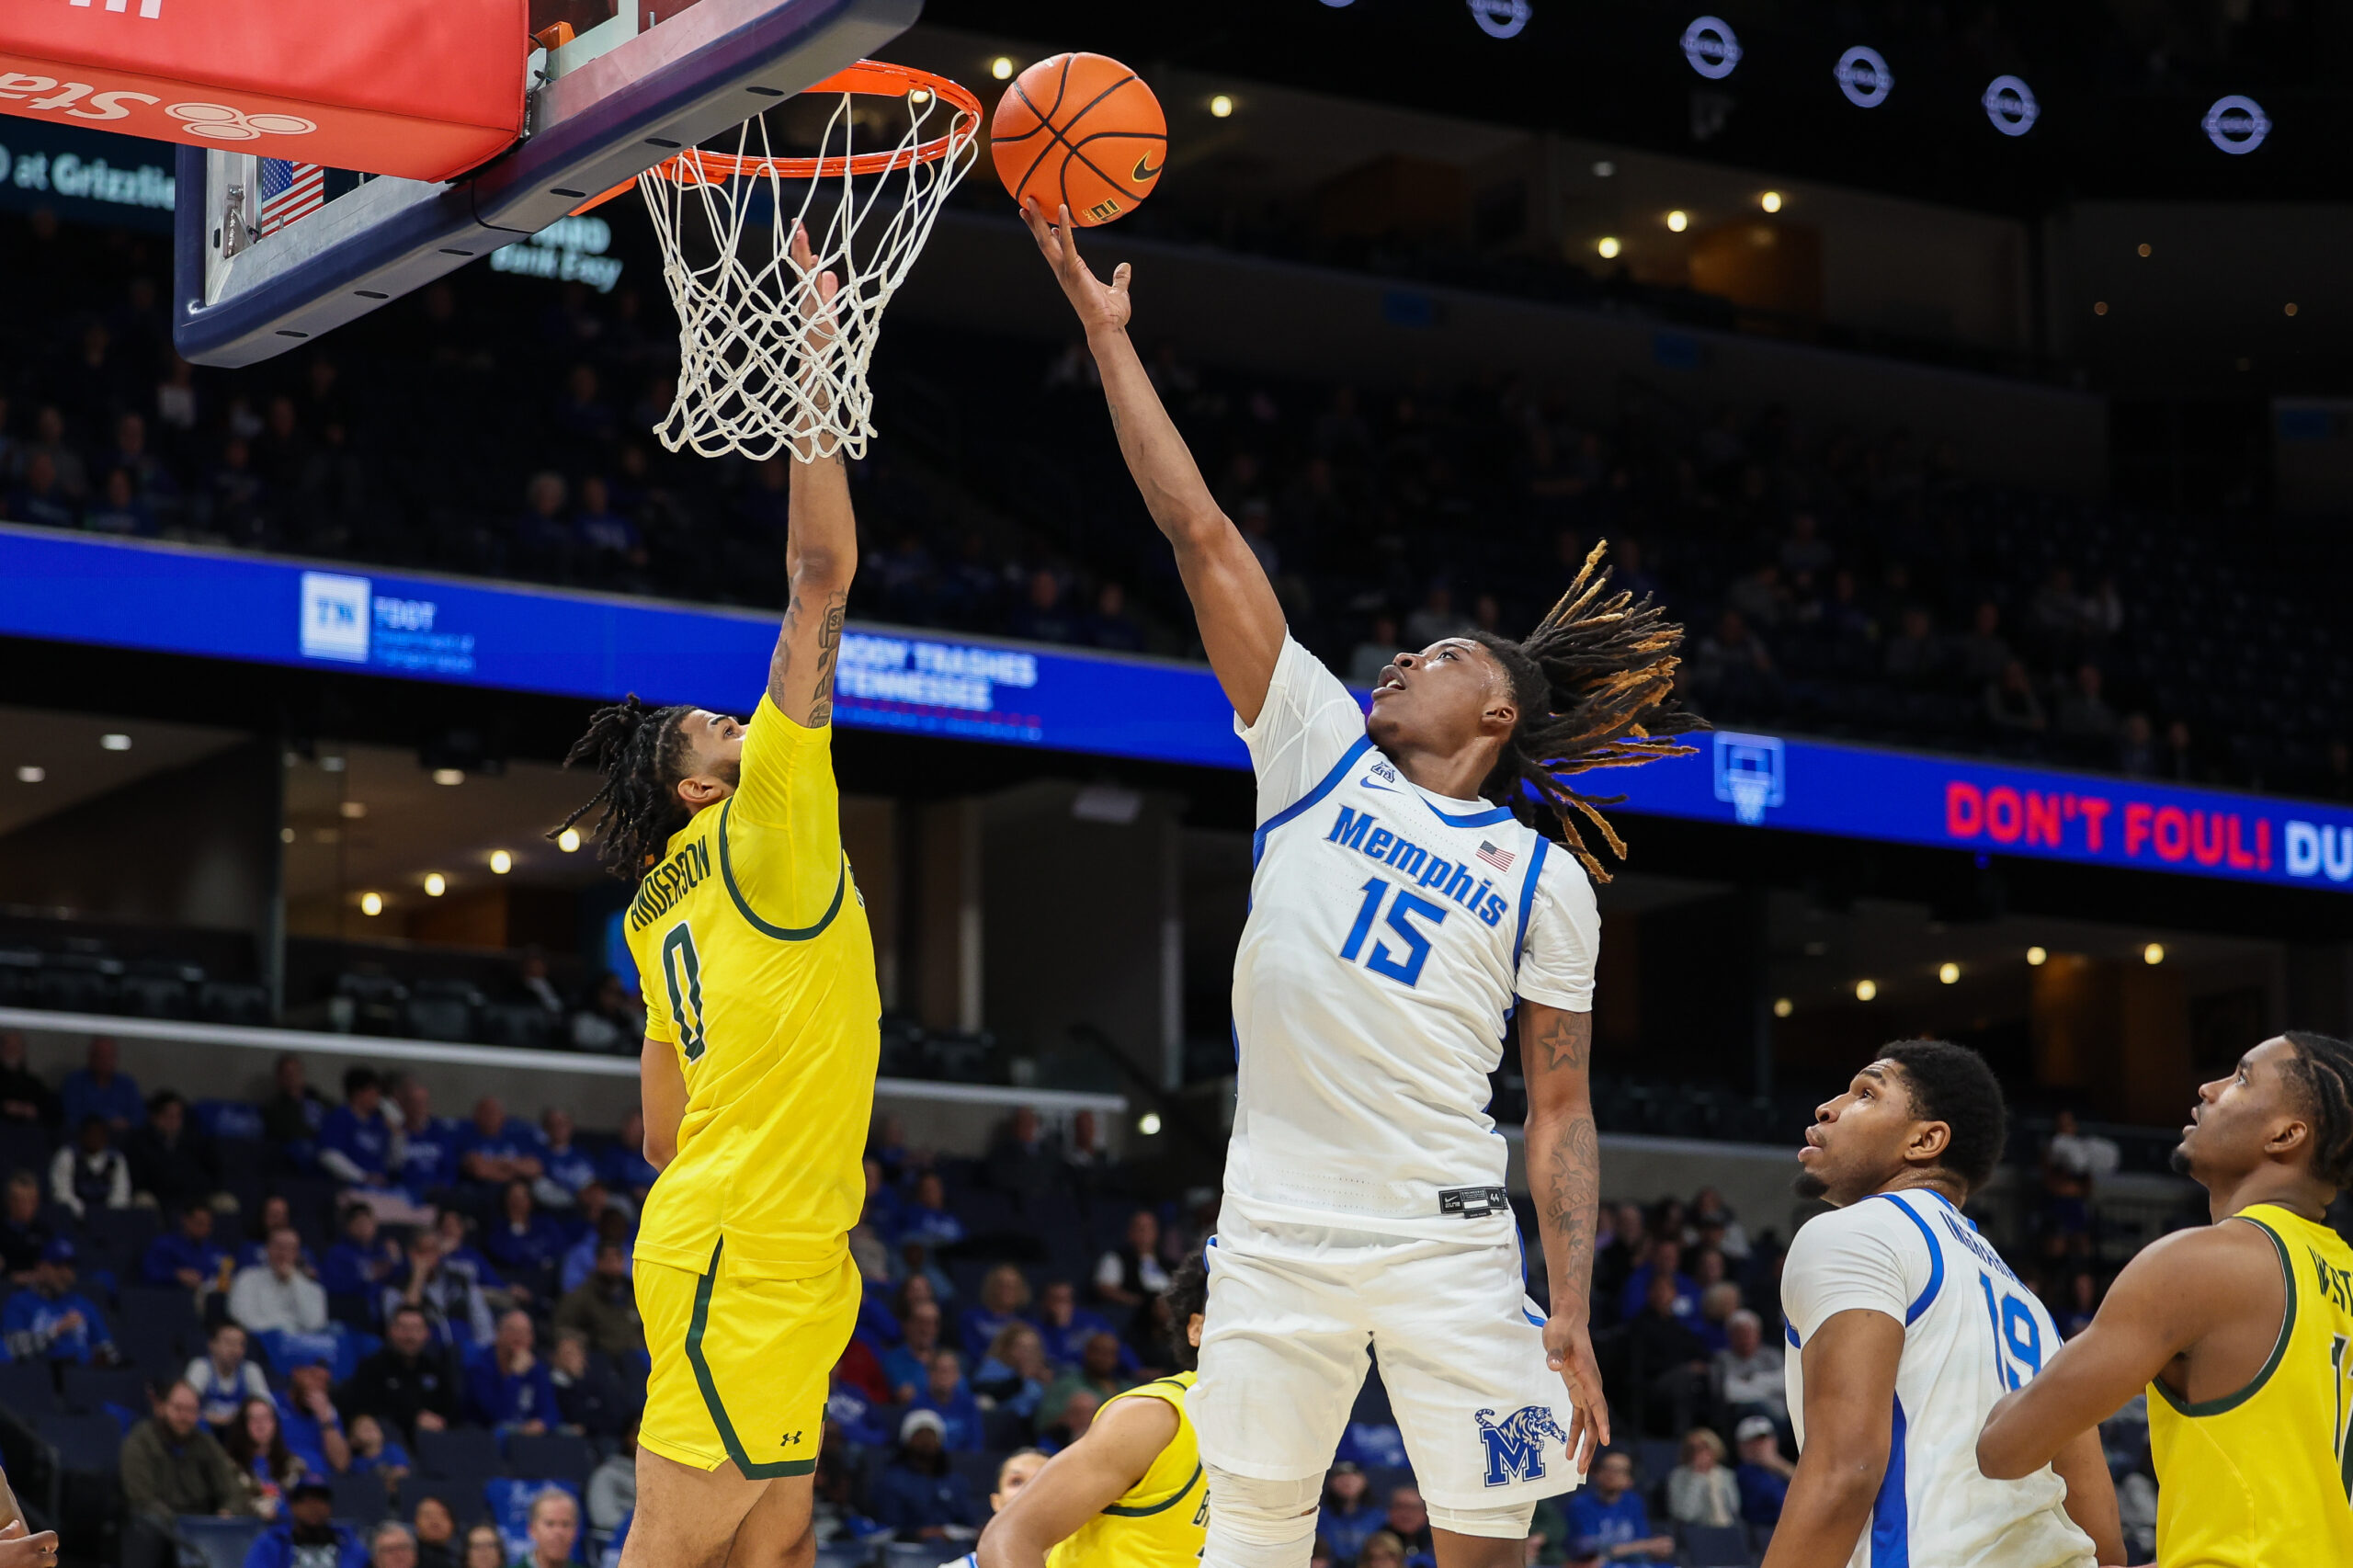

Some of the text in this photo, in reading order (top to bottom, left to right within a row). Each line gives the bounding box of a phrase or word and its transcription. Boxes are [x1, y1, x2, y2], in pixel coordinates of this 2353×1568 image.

[631, 835, 711, 932] ANDERSON
[1323, 802, 1509, 928] Memphis
[1947, 781, 2110, 853] DON'T
[2124, 801, 2272, 872] FOUL!
[661, 919, 707, 1066] 0
[1338, 875, 1449, 990] 15
[1978, 1266, 2042, 1394] 19
